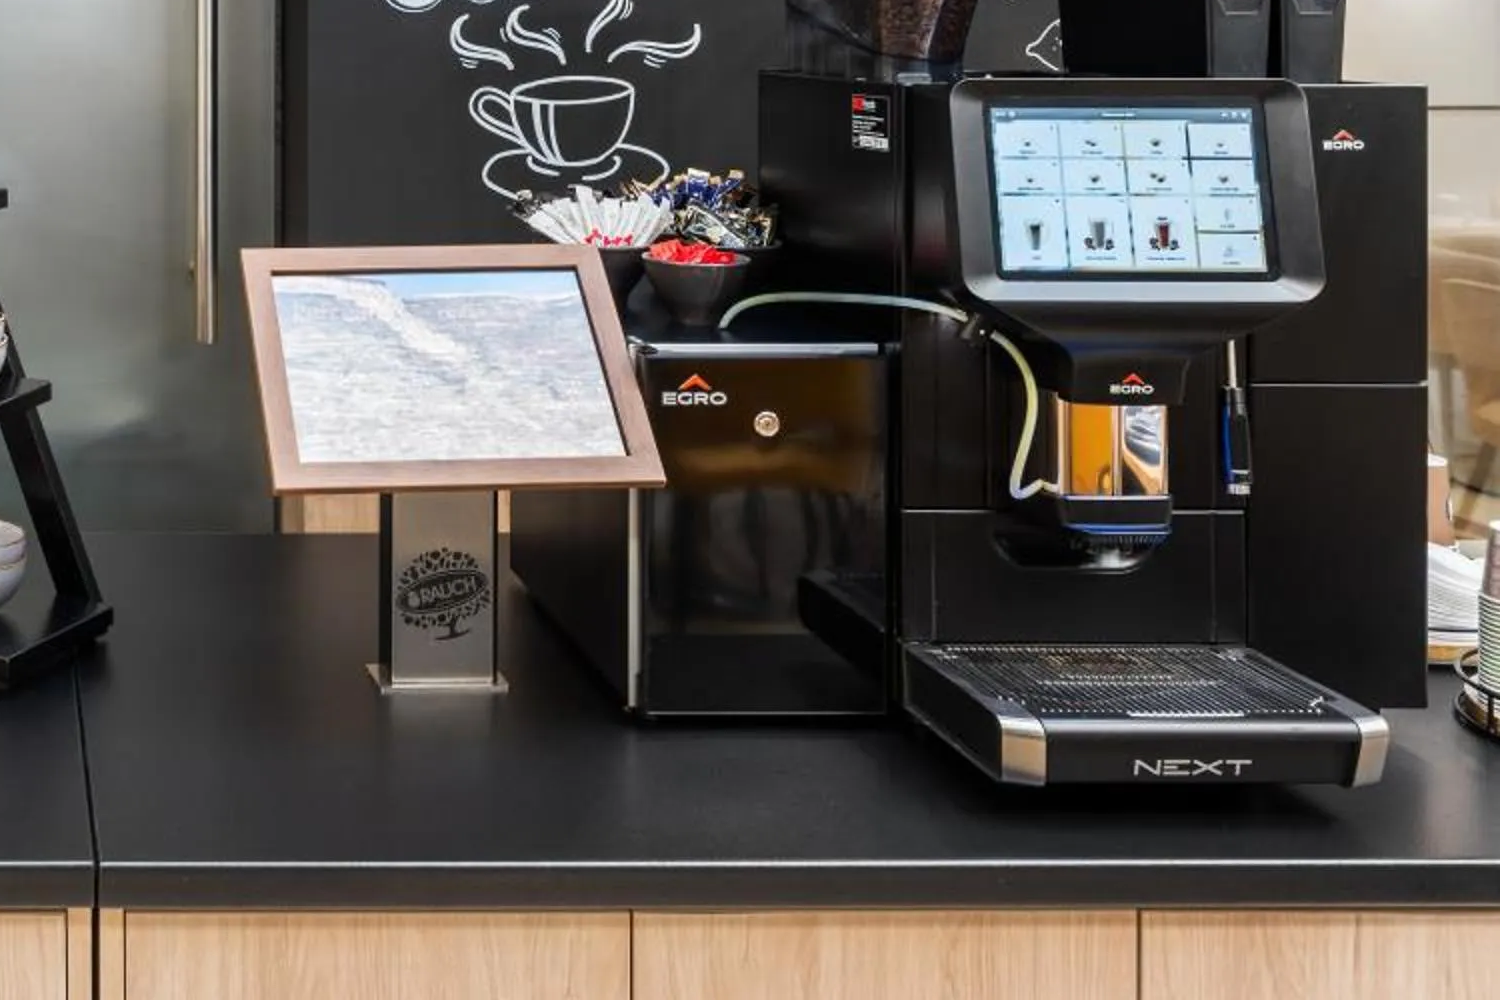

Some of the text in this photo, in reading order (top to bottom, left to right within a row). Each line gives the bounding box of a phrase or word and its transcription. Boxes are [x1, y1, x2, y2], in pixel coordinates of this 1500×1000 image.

[1323, 139, 1365, 151] EGRO
[1109, 384, 1155, 395] EGRO
[661, 391, 728, 406] EGRO
[1133, 758, 1253, 776] NEXT
